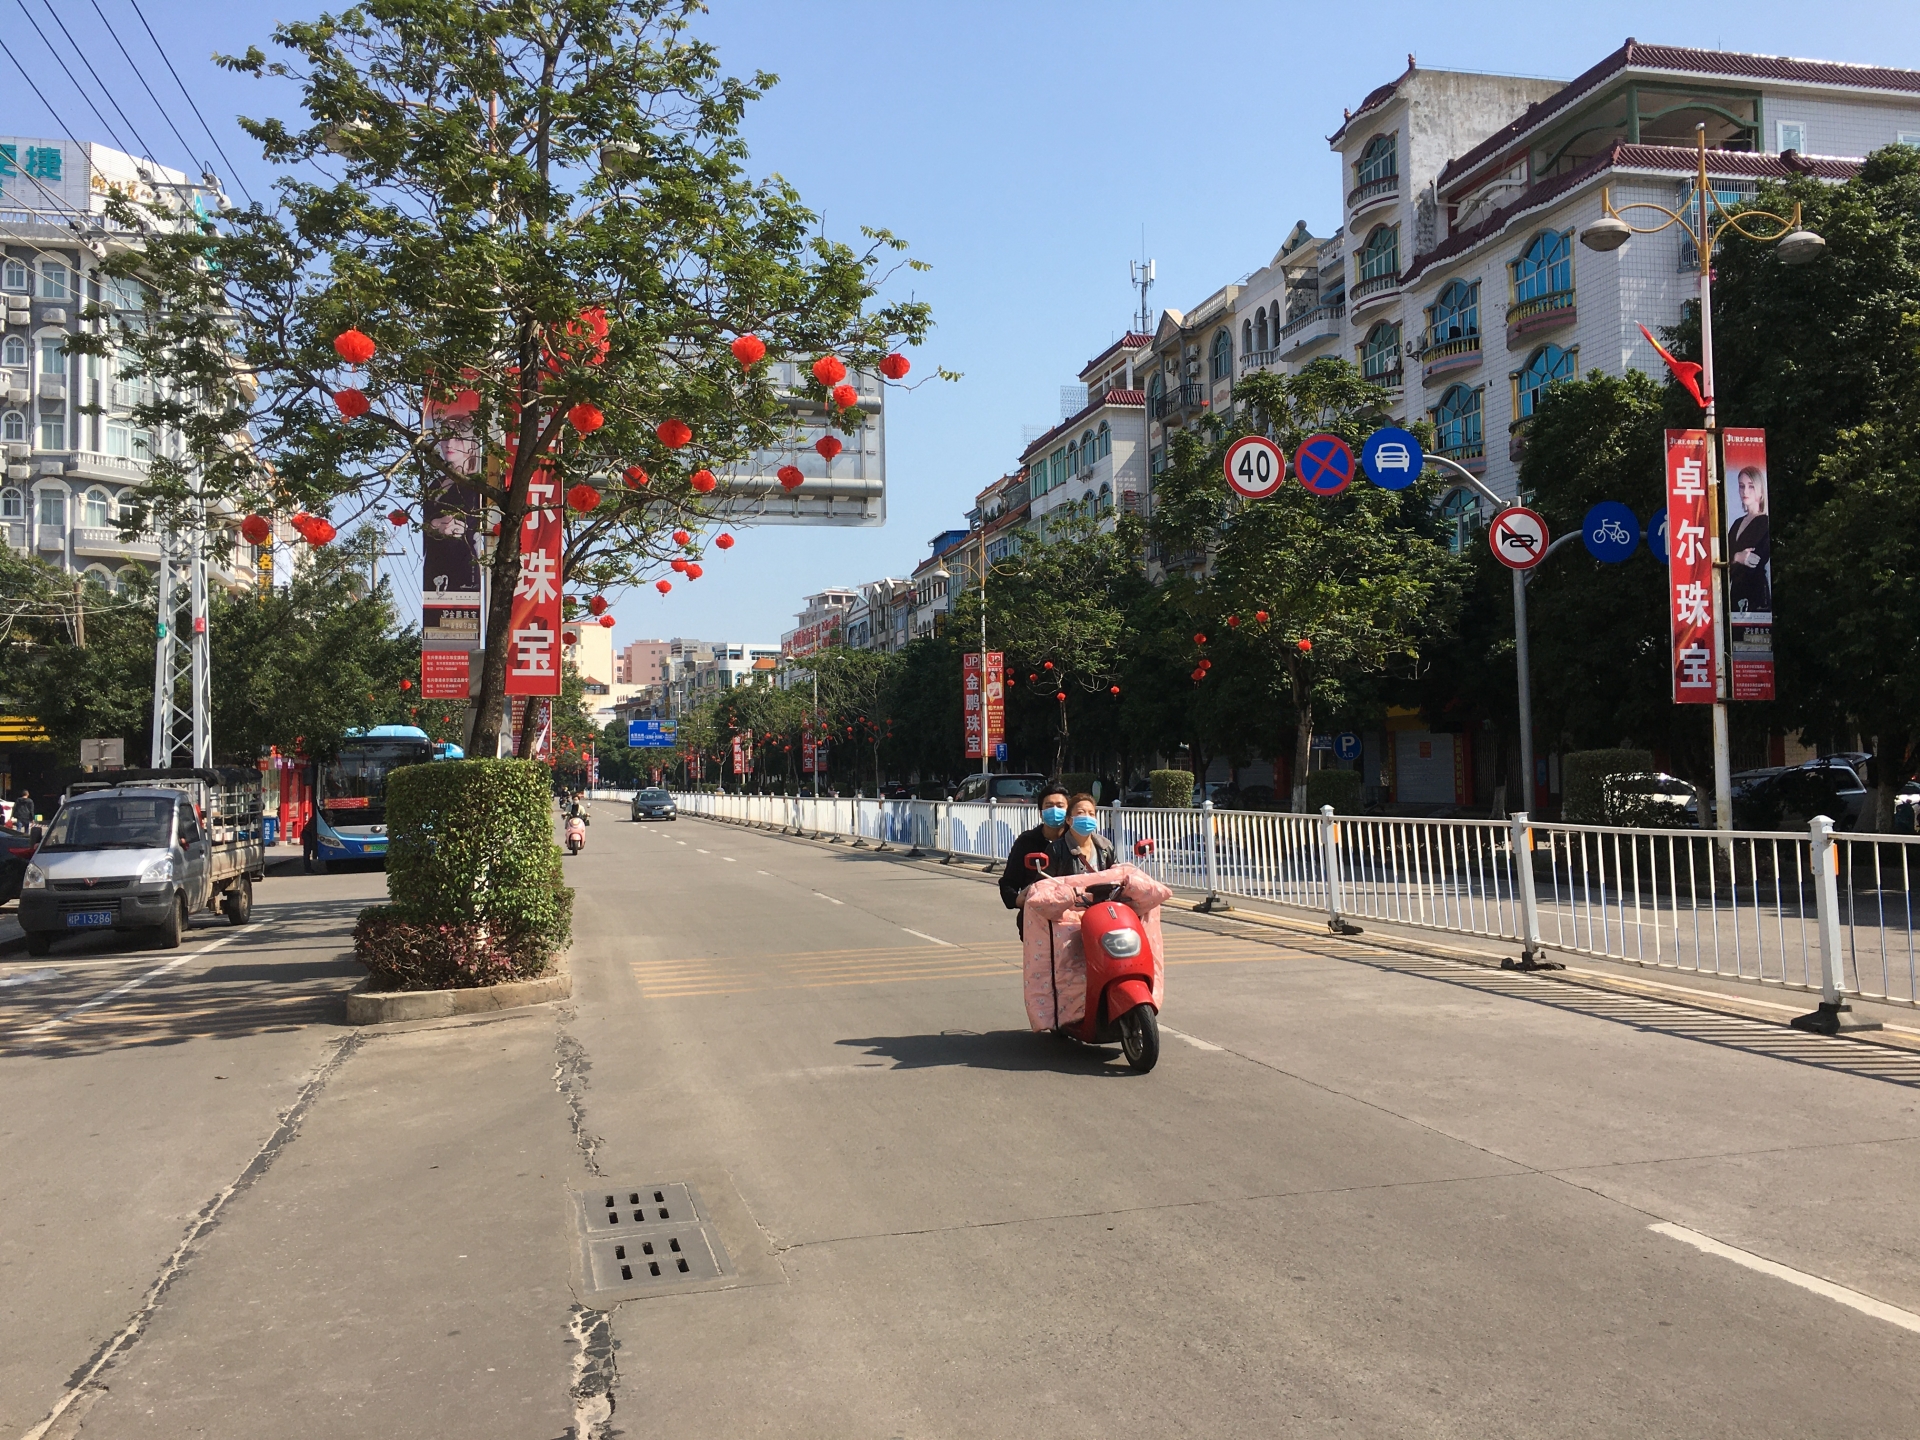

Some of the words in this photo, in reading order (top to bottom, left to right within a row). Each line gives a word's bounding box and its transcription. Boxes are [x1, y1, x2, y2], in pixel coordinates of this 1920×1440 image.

[1238, 450, 1271, 483] 40
[1673, 457, 1711, 688] 卓尔珠宝
[966, 656, 978, 667] JP
[966, 672, 981, 753] 金鹏珠宝
[1341, 735, 1355, 752] P
